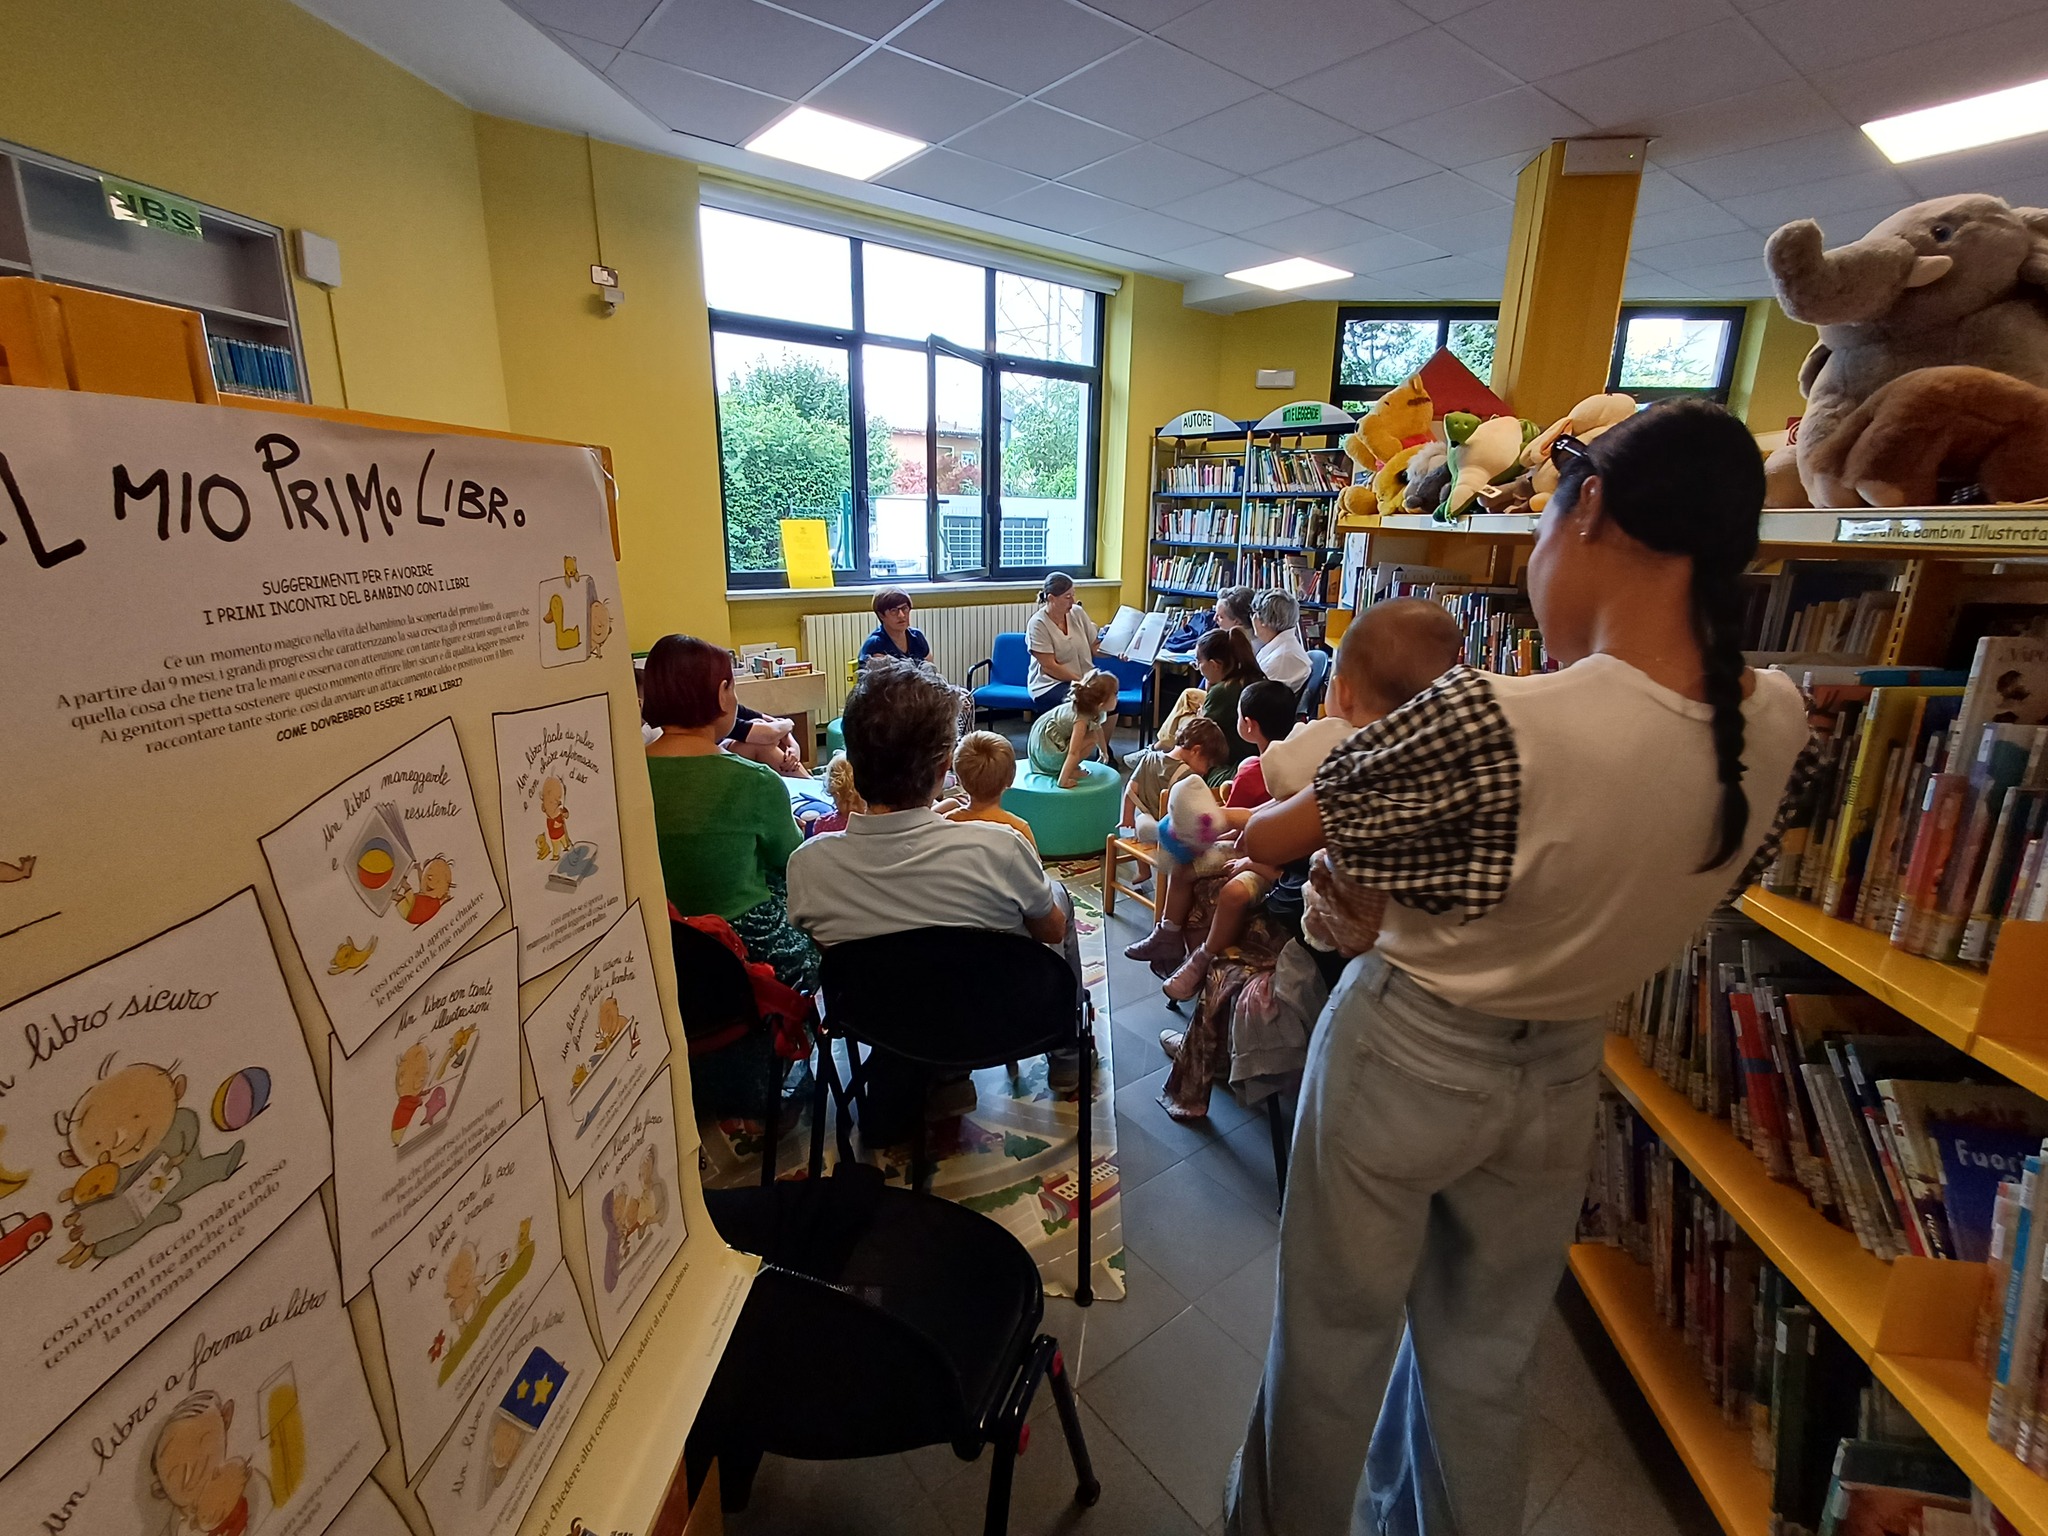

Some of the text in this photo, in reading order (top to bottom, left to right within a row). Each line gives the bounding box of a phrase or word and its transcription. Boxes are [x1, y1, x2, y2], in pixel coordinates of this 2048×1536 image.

[1183, 413, 1212, 428] AUTORE
[1295, 406, 1319, 421] LEGGENDE
[0, 452, 87, 569] L
[112, 463, 251, 542] MIO
[202, 576, 470, 626] I PRIMI INCONTRI DEL BAMBINO CON I LIBRI
[262, 563, 434, 596] SUGGERIMENTI PER FAVORIRE
[185, 654, 205, 666] un
[210, 642, 272, 662] momento
[273, 635, 312, 650] magico
[312, 628, 337, 642] nella
[57, 694, 71, 709] A
[73, 685, 137, 710] partire
[140, 679, 166, 694] dai
[167, 675, 178, 687] 9
[218, 669, 224, 679] i
[225, 658, 267, 680] grandi
[267, 651, 317, 671] progressi
[71, 705, 127, 730] quella
[129, 700, 166, 716] cosa
[169, 693, 196, 708] che
[198, 686, 233, 702] tiene
[235, 681, 255, 694] tra
[255, 677, 267, 689] le
[268, 672, 298, 687] mani
[276, 676, 463, 742] COME DOVREBBERO ESSERE I PRIMI LIBRI?
[100, 729, 118, 743] Ai
[120, 716, 185, 742] genitori
[187, 705, 232, 725] spetta
[234, 691, 290, 713] sostenere
[294, 682, 329, 700] questo
[145, 725, 226, 753] raccontare
[227, 716, 263, 733] tante
[320, 695, 333, 708] da
[323, 765, 451, 850] Un libro maneggevole
[331, 802, 462, 871] e resistente
[25, 985, 219, 1069] libro sicuro
[81, 1287, 119, 1319] non
[121, 1265, 145, 1289] mi
[148, 1228, 196, 1268] faccio
[197, 1198, 235, 1231] male
[237, 1190, 246, 1201] e
[248, 1158, 287, 1195] posso
[43, 1181, 280, 1370] tenerlo con me anche quando
[102, 1325, 121, 1343] la
[123, 1267, 194, 1328] mamma
[196, 1241, 227, 1269] non
[42, 1287, 328, 1535] Un libro a forma di libro
